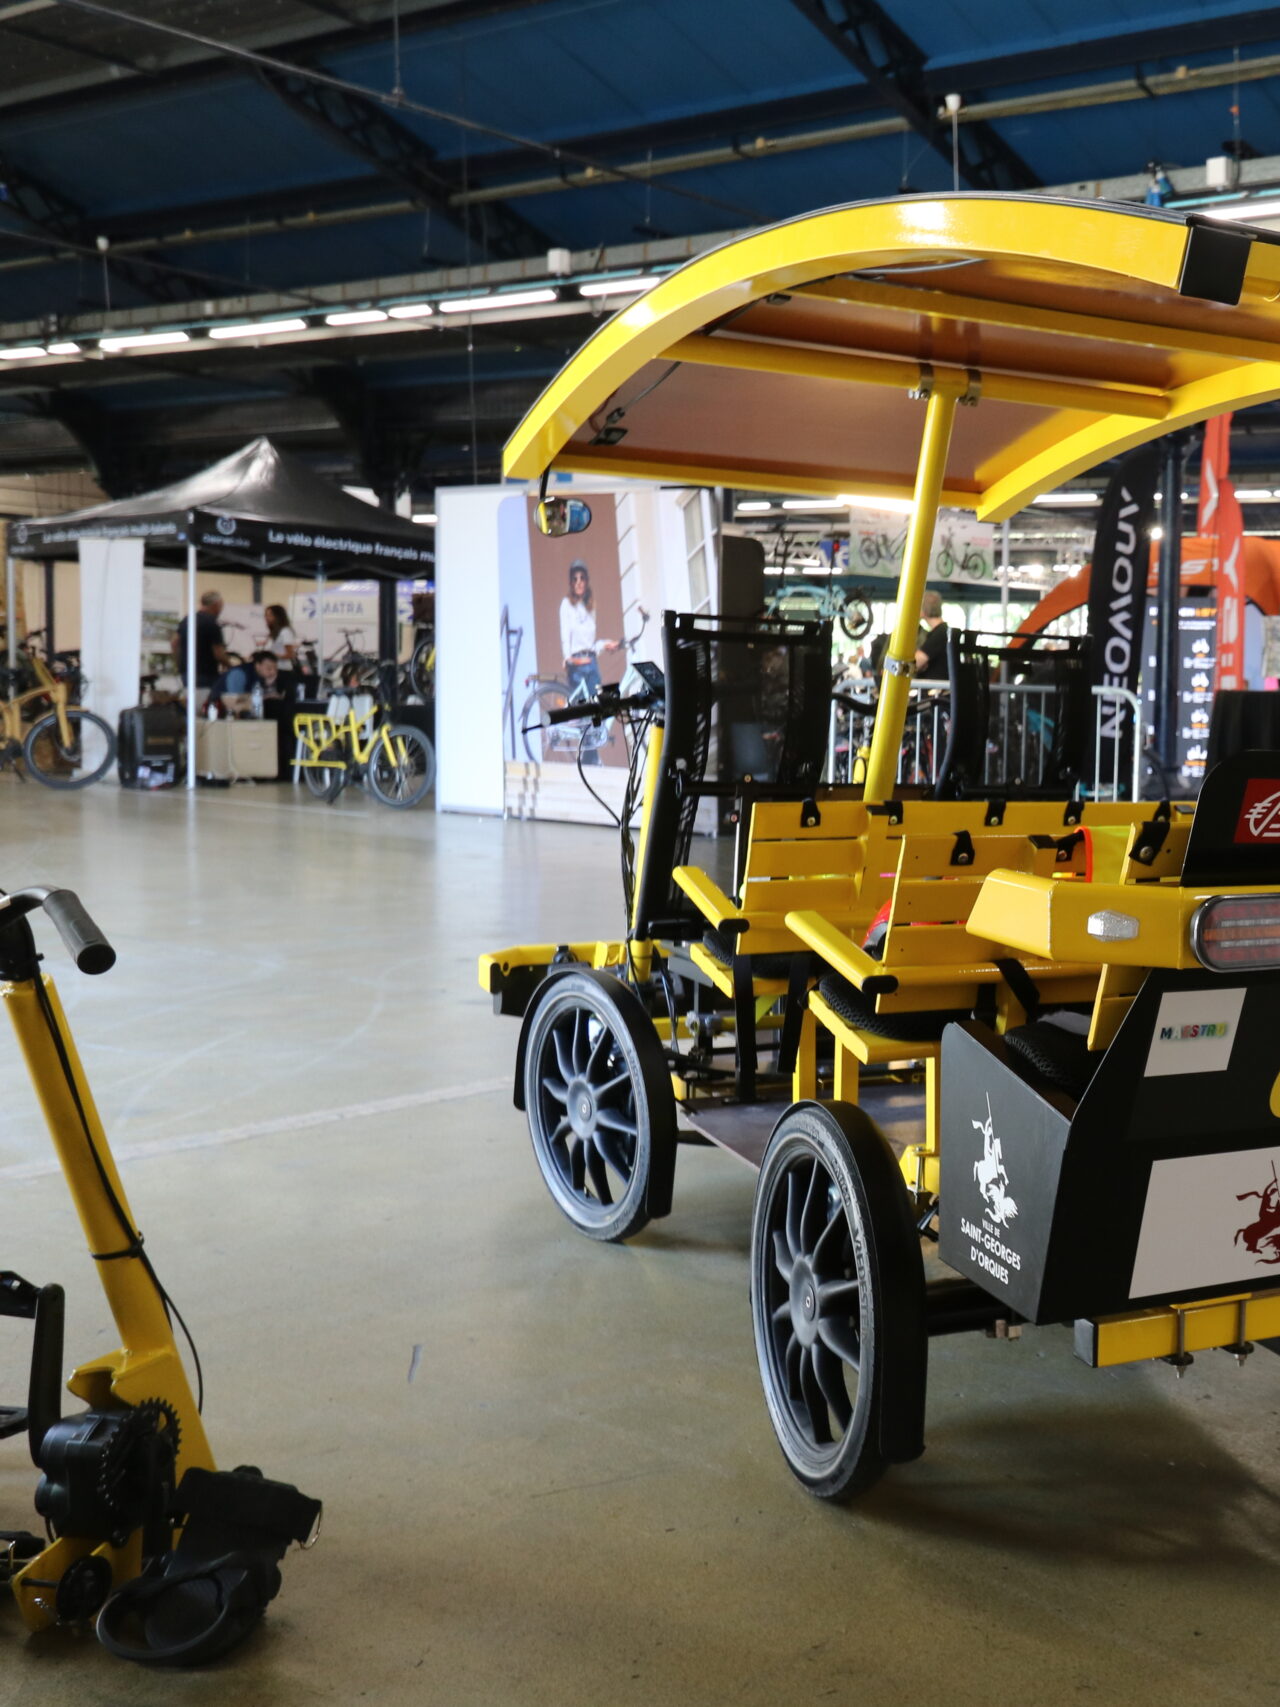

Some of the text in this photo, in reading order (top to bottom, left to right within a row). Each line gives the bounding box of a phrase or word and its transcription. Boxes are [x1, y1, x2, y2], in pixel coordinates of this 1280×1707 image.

[268, 529, 285, 543] Le
[286, 532, 314, 547] vélo
[314, 533, 373, 555] électrique
[374, 541, 418, 561] français
[1100, 486, 1140, 739] NEOMOUV
[961, 1217, 1021, 1271] SAINT-GEORGES
[982, 1218, 993, 1234] VILLE
[971, 1245, 1009, 1285] D'ORQUES
